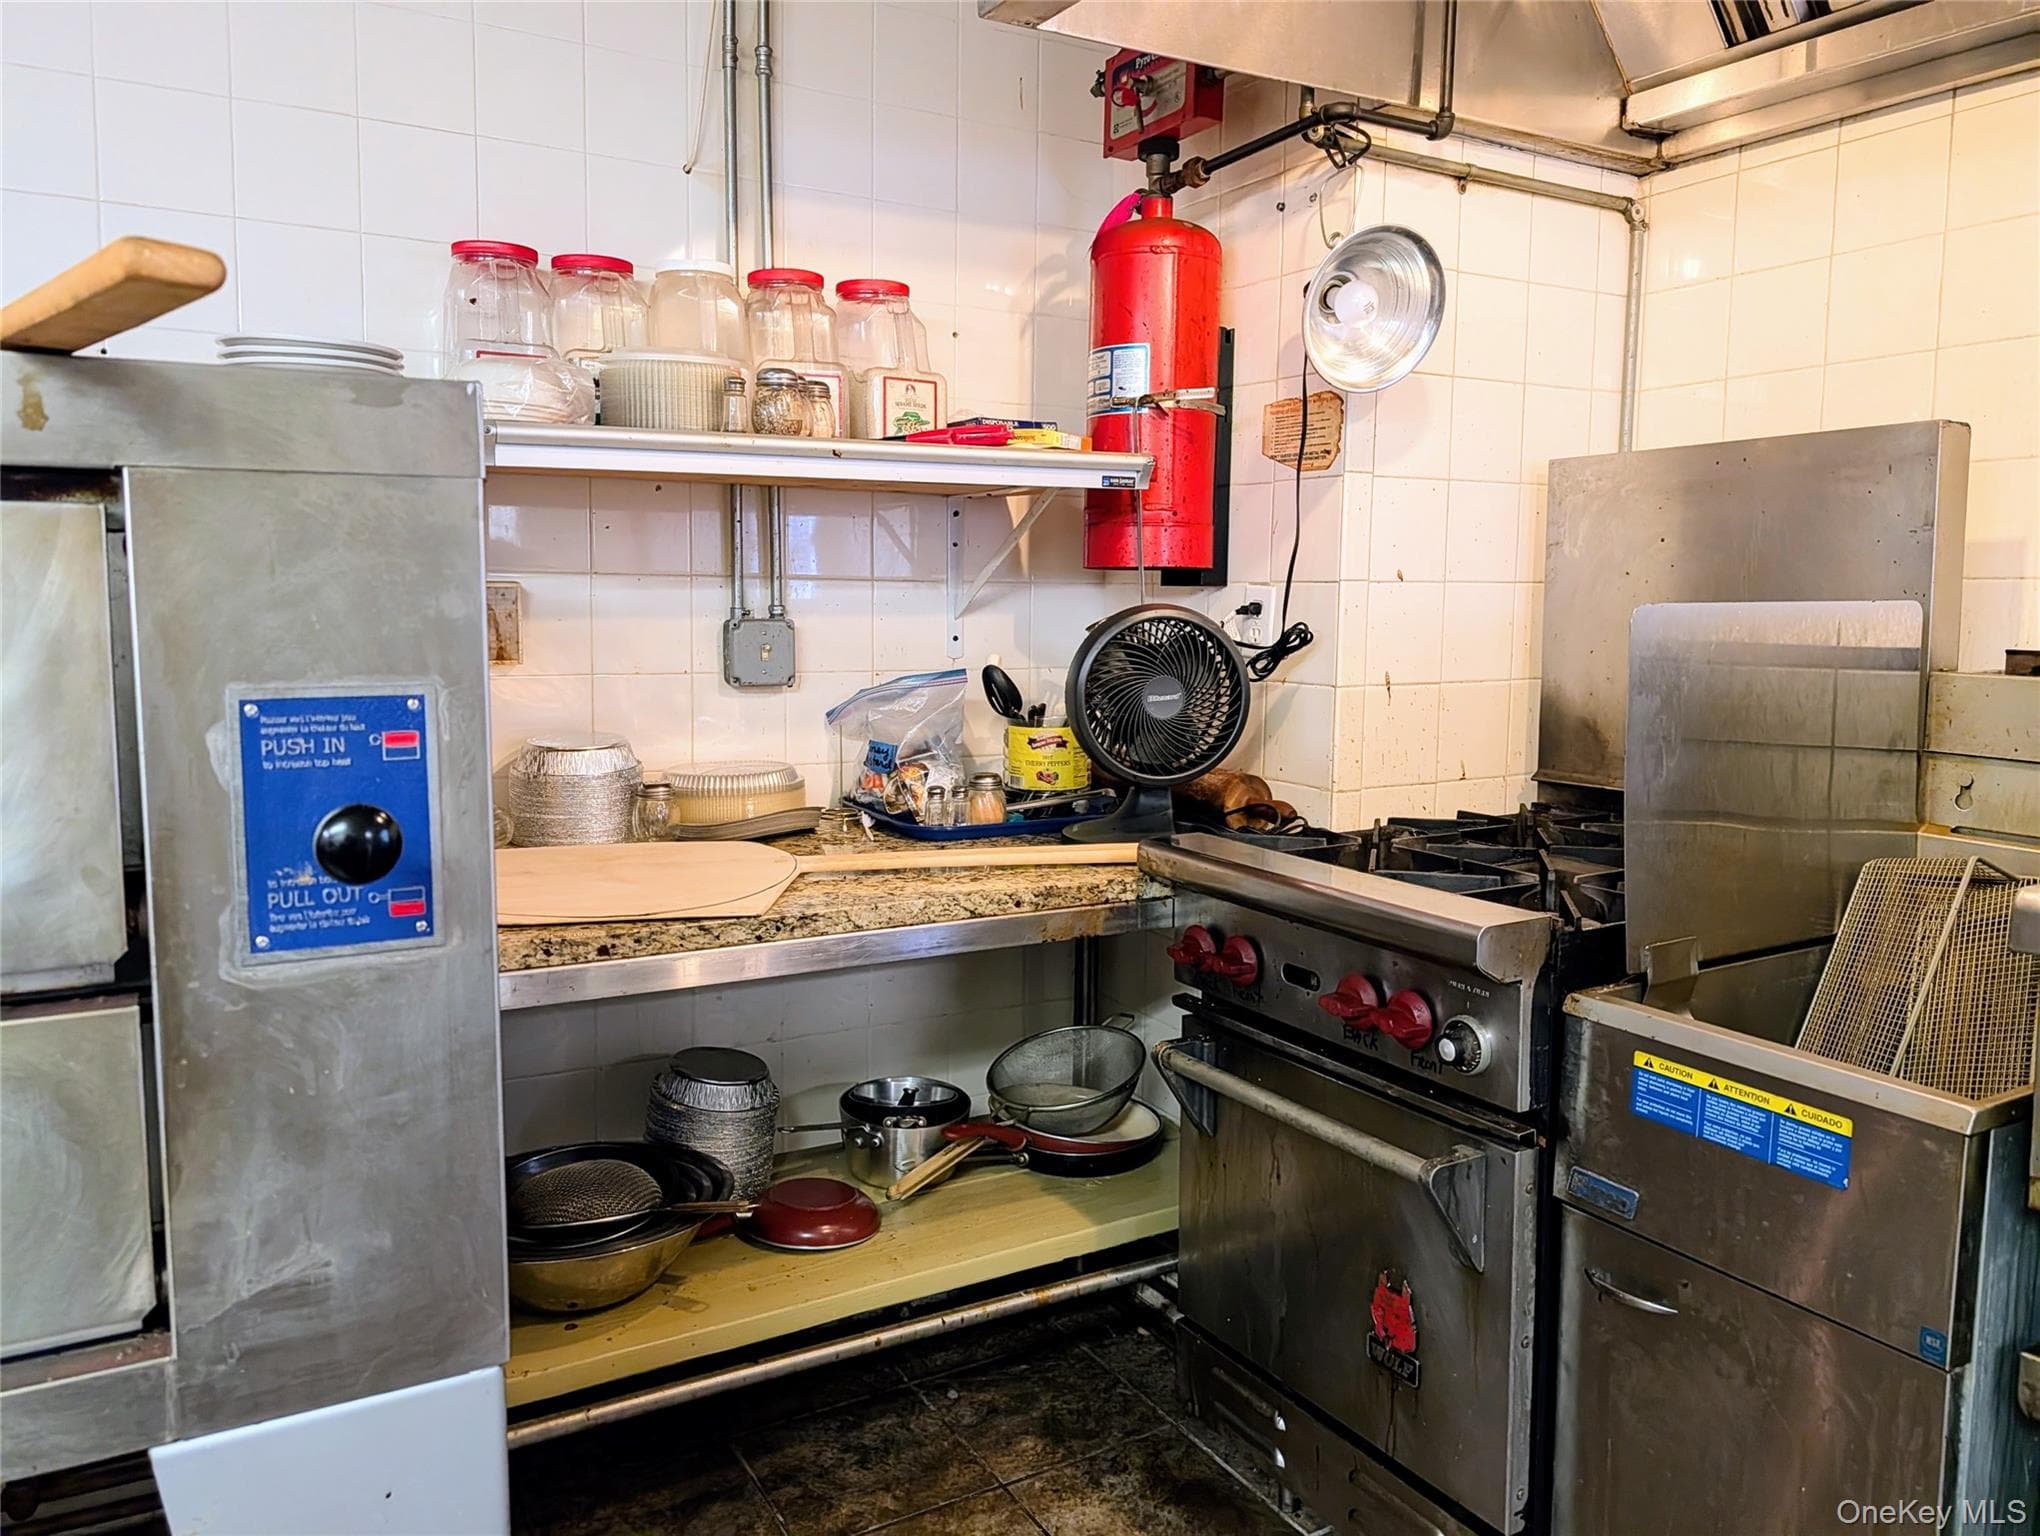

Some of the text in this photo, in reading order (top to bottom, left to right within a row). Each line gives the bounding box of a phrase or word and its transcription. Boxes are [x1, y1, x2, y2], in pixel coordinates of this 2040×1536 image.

[261, 735, 346, 756] PUSH IN
[267, 886, 364, 910] PULL OUT
[1658, 1062, 1694, 1080] CAUTION
[1723, 1084, 1770, 1105] ATTENTION
[1801, 1109, 1843, 1129] CUIDADO
